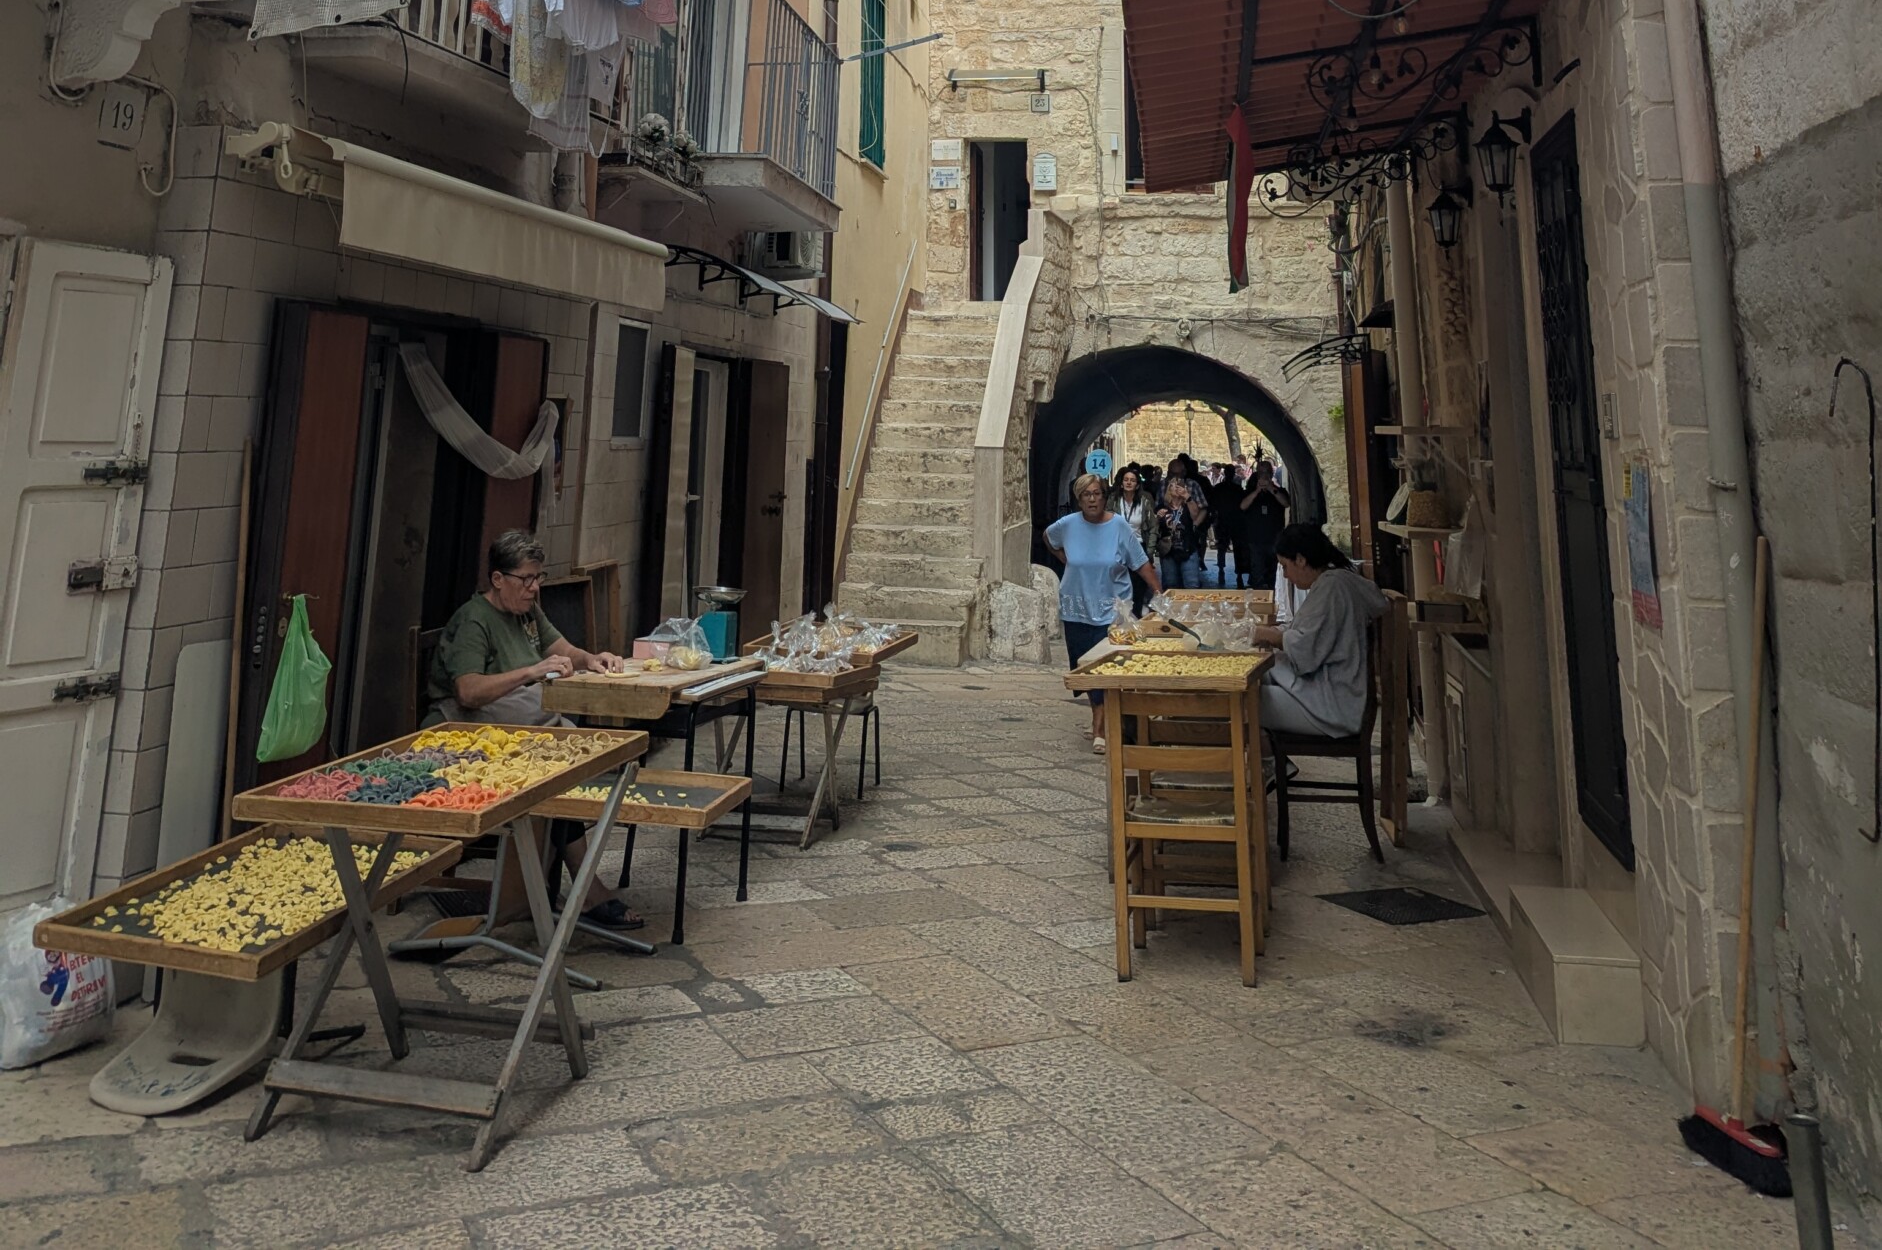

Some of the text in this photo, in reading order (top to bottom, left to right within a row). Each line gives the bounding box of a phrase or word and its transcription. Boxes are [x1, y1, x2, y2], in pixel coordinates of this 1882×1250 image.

[1035, 99, 1045, 108] 23
[112, 101, 134, 131] 19
[1092, 458, 1106, 469] 14
